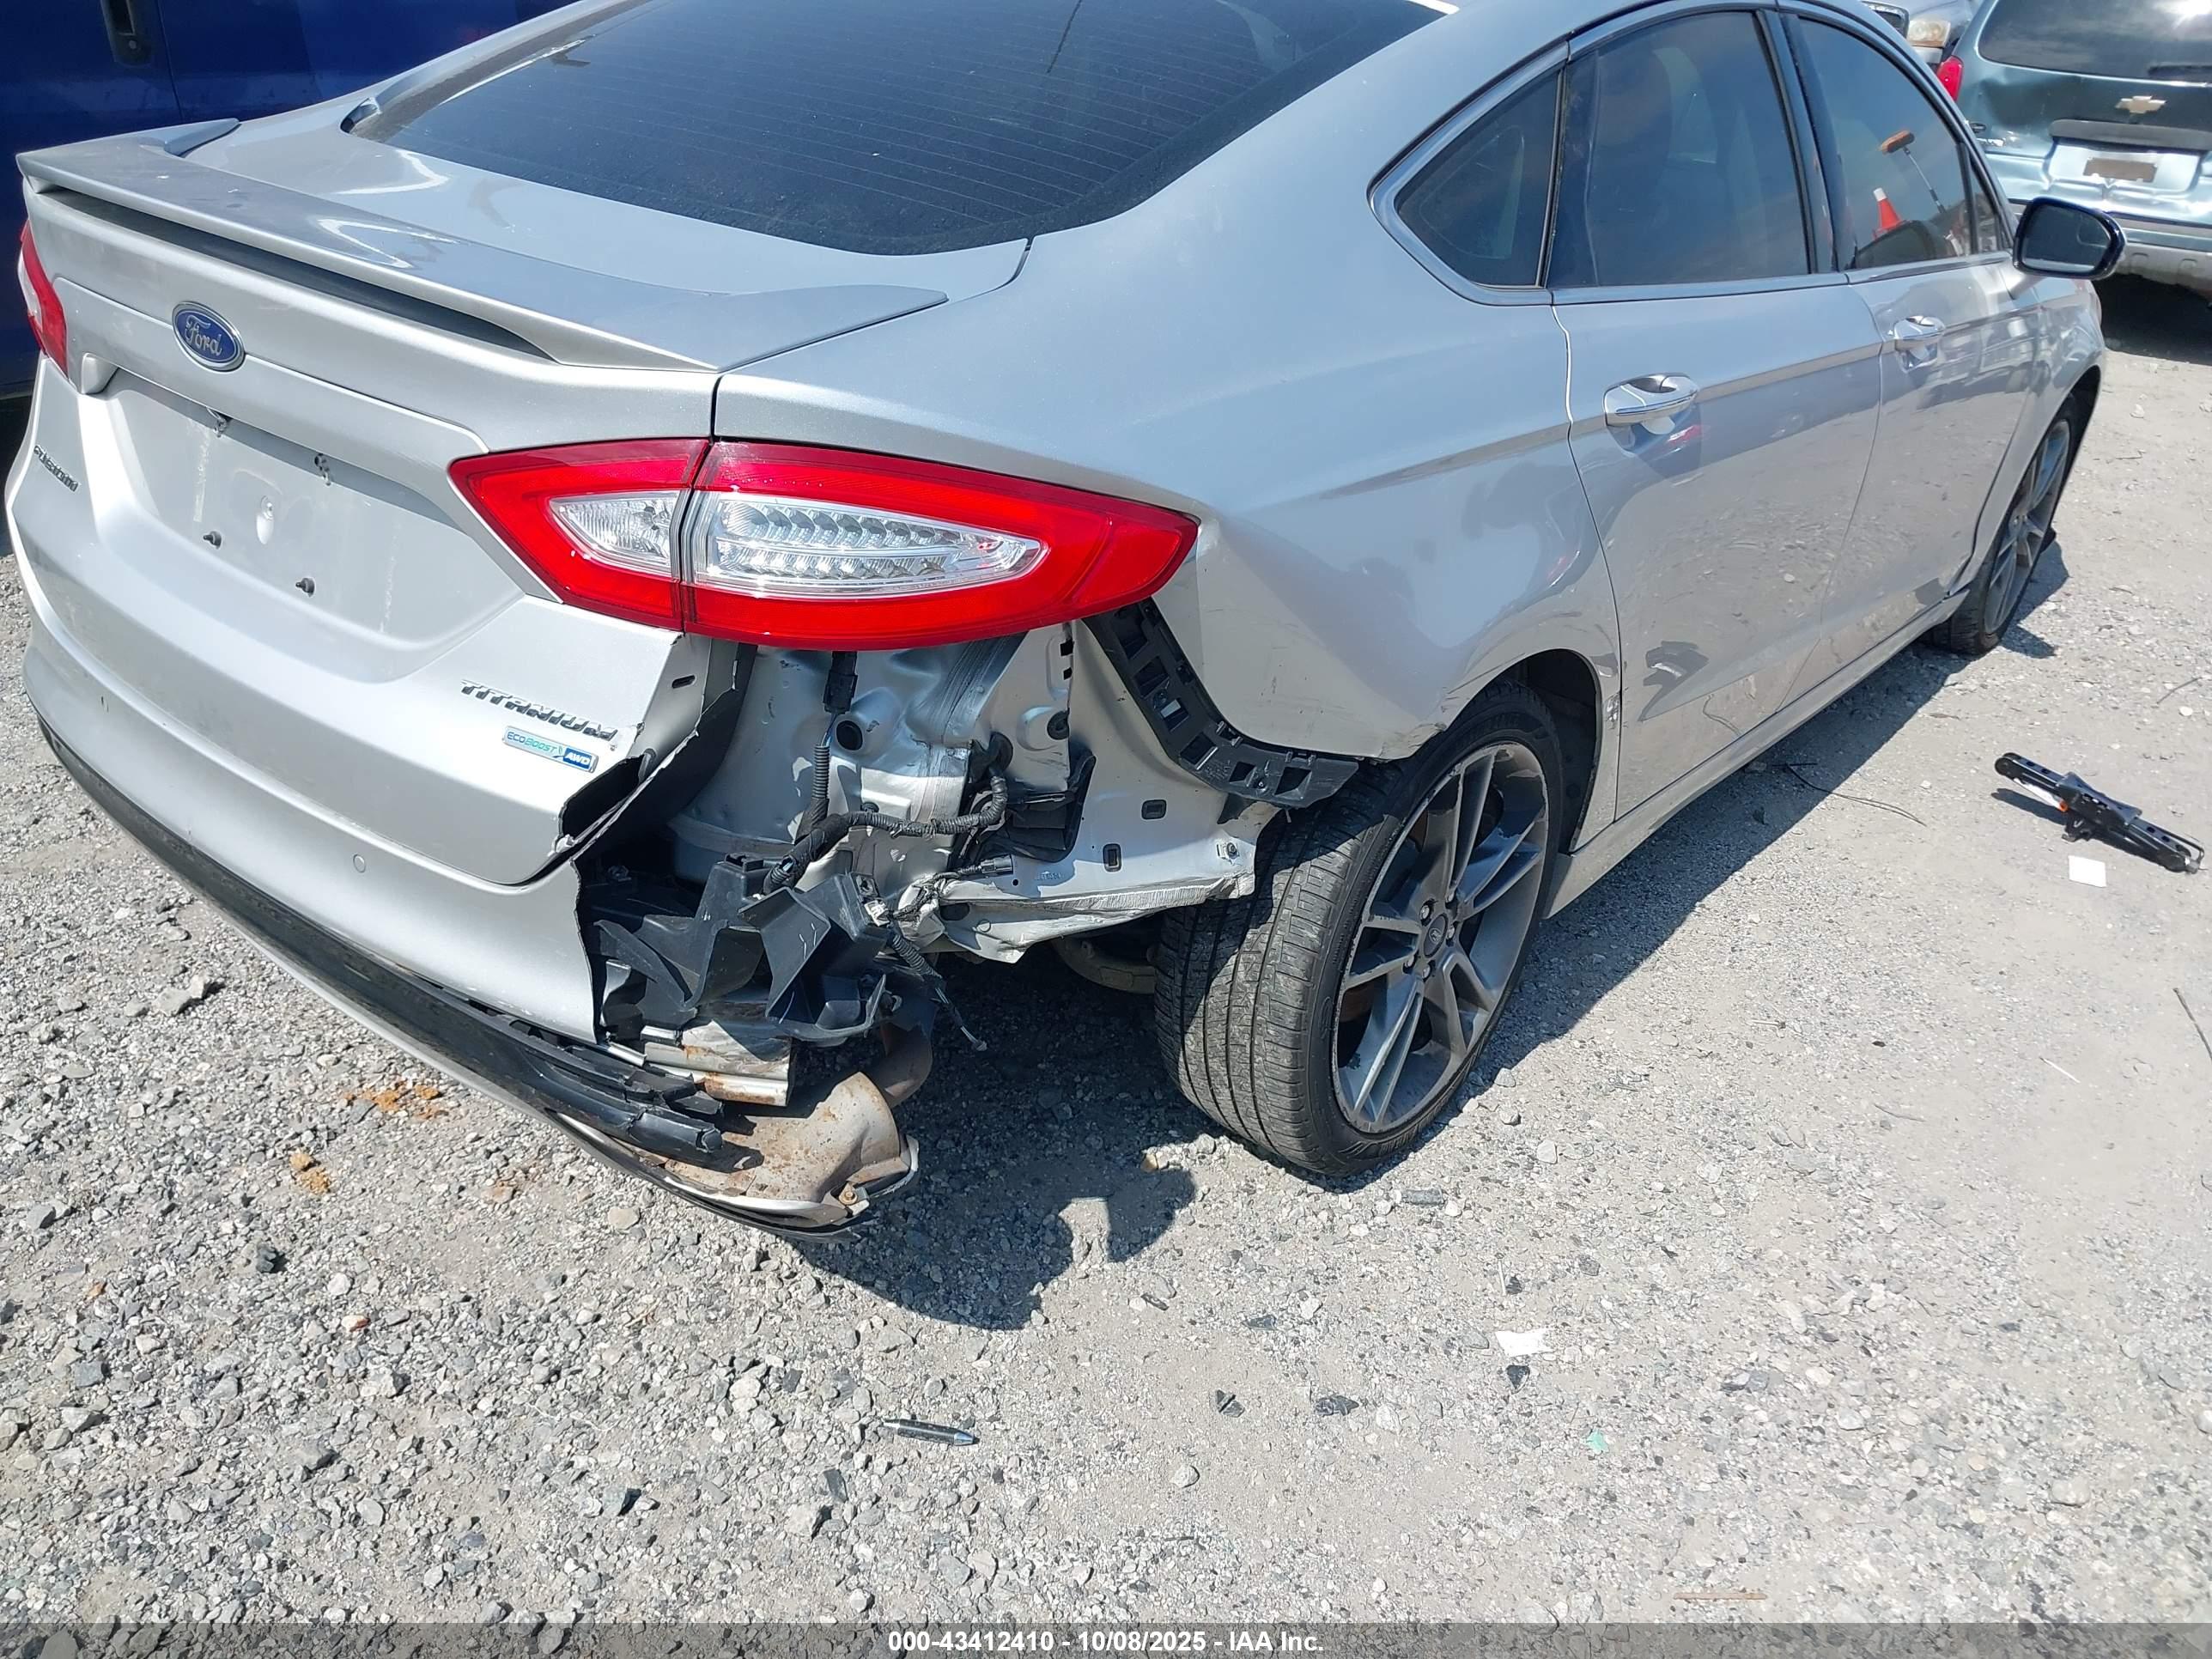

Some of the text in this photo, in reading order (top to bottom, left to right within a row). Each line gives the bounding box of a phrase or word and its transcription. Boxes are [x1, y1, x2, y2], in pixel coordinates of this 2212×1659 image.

[185, 314, 222, 356] Ford
[461, 679, 618, 741] TITANIUM
[564, 750, 592, 766] AWD
